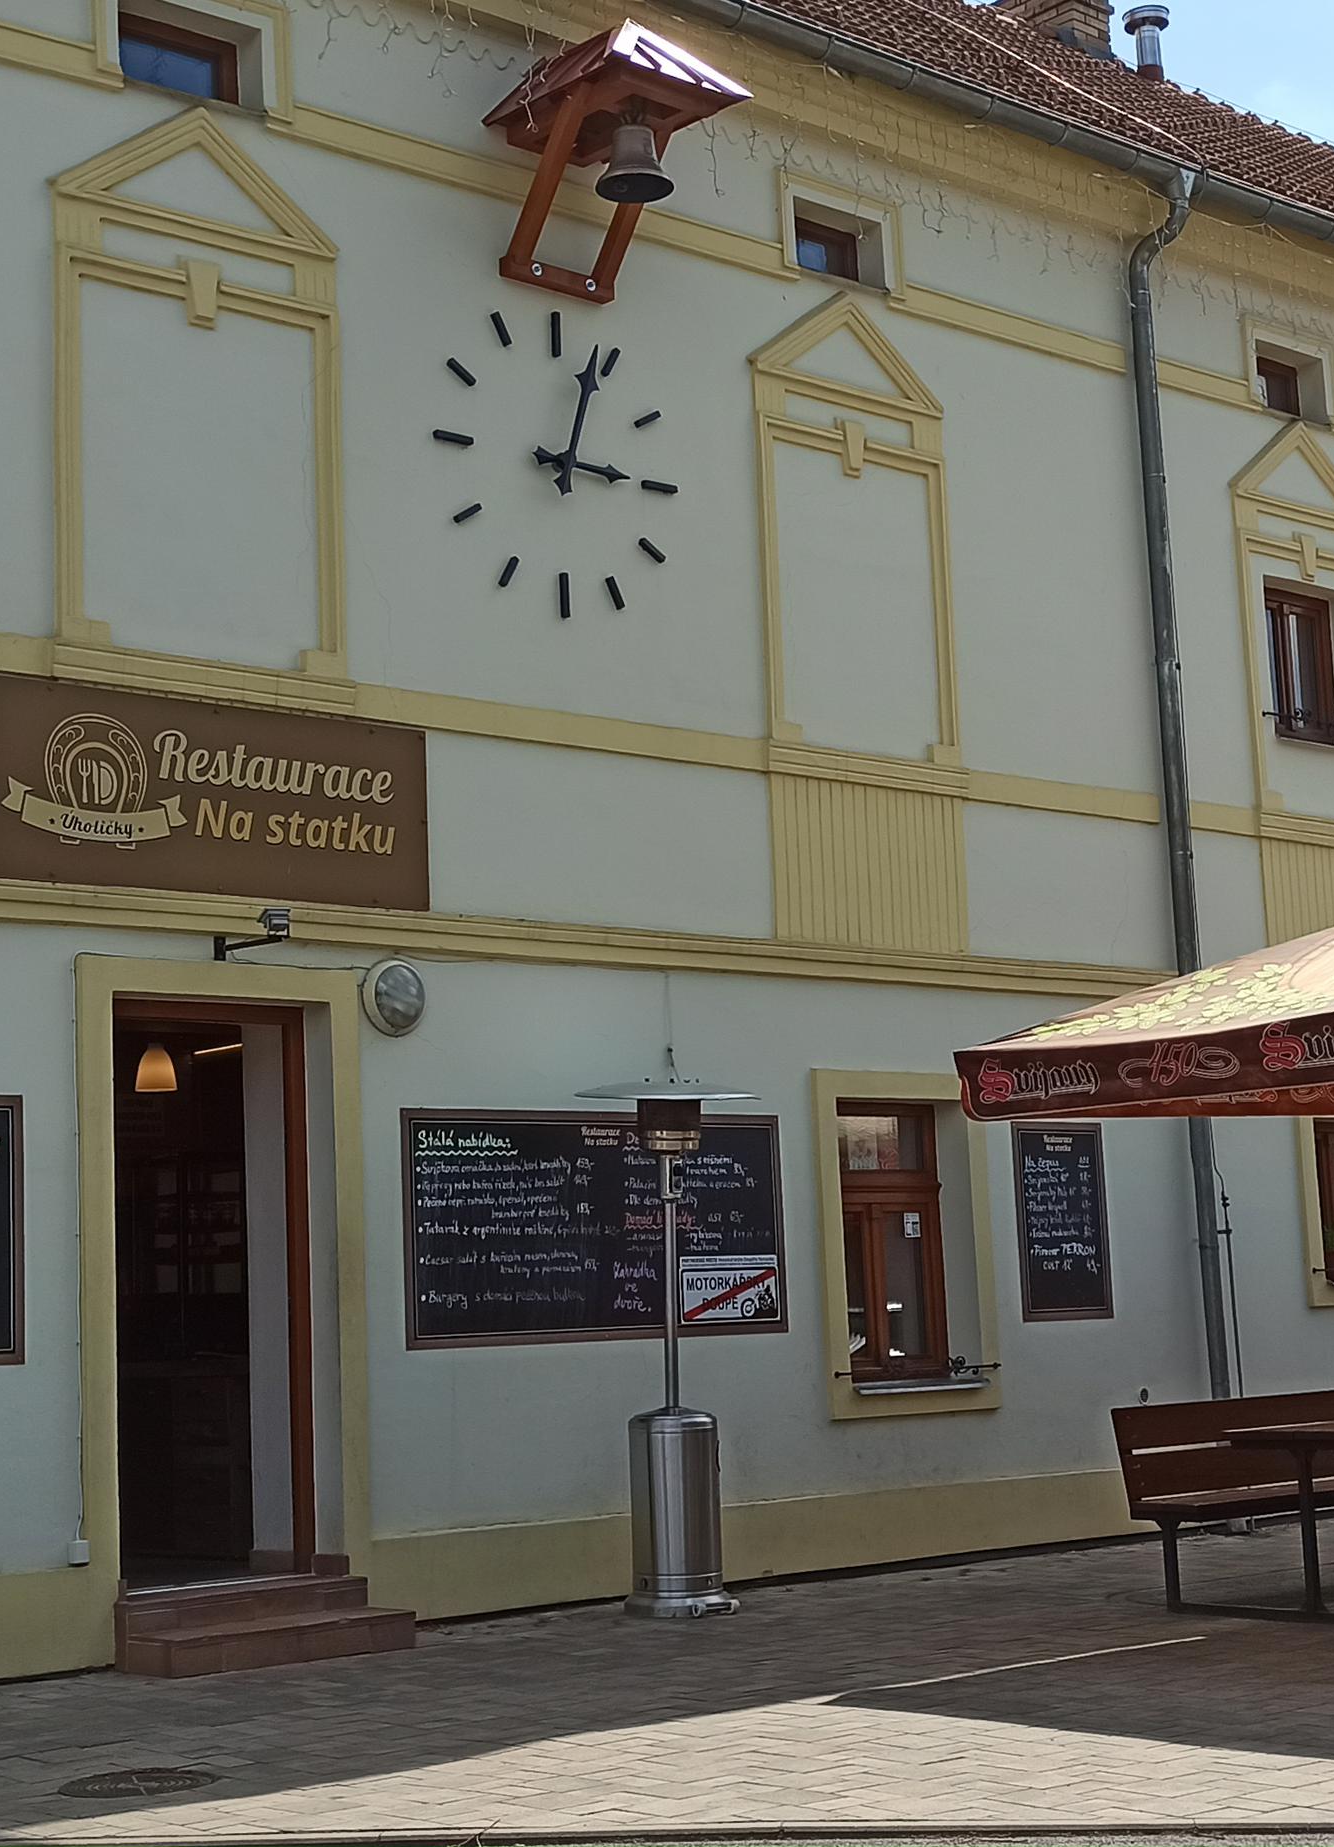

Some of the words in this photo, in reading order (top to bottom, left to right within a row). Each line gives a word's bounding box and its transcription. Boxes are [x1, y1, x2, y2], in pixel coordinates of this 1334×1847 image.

[153, 729, 395, 803] Restaurace
[60, 810, 134, 839] Úholičky
[194, 798, 254, 842] Na
[265, 811, 396, 855] statku
[978, 1057, 1101, 1104] Svijany
[1147, 1041, 1199, 1086] 450
[418, 1129, 455, 1149] Stálá
[457, 1131, 512, 1149] nabídka:
[581, 1126, 622, 1137] Restaurace
[596, 1137, 619, 1147] statku
